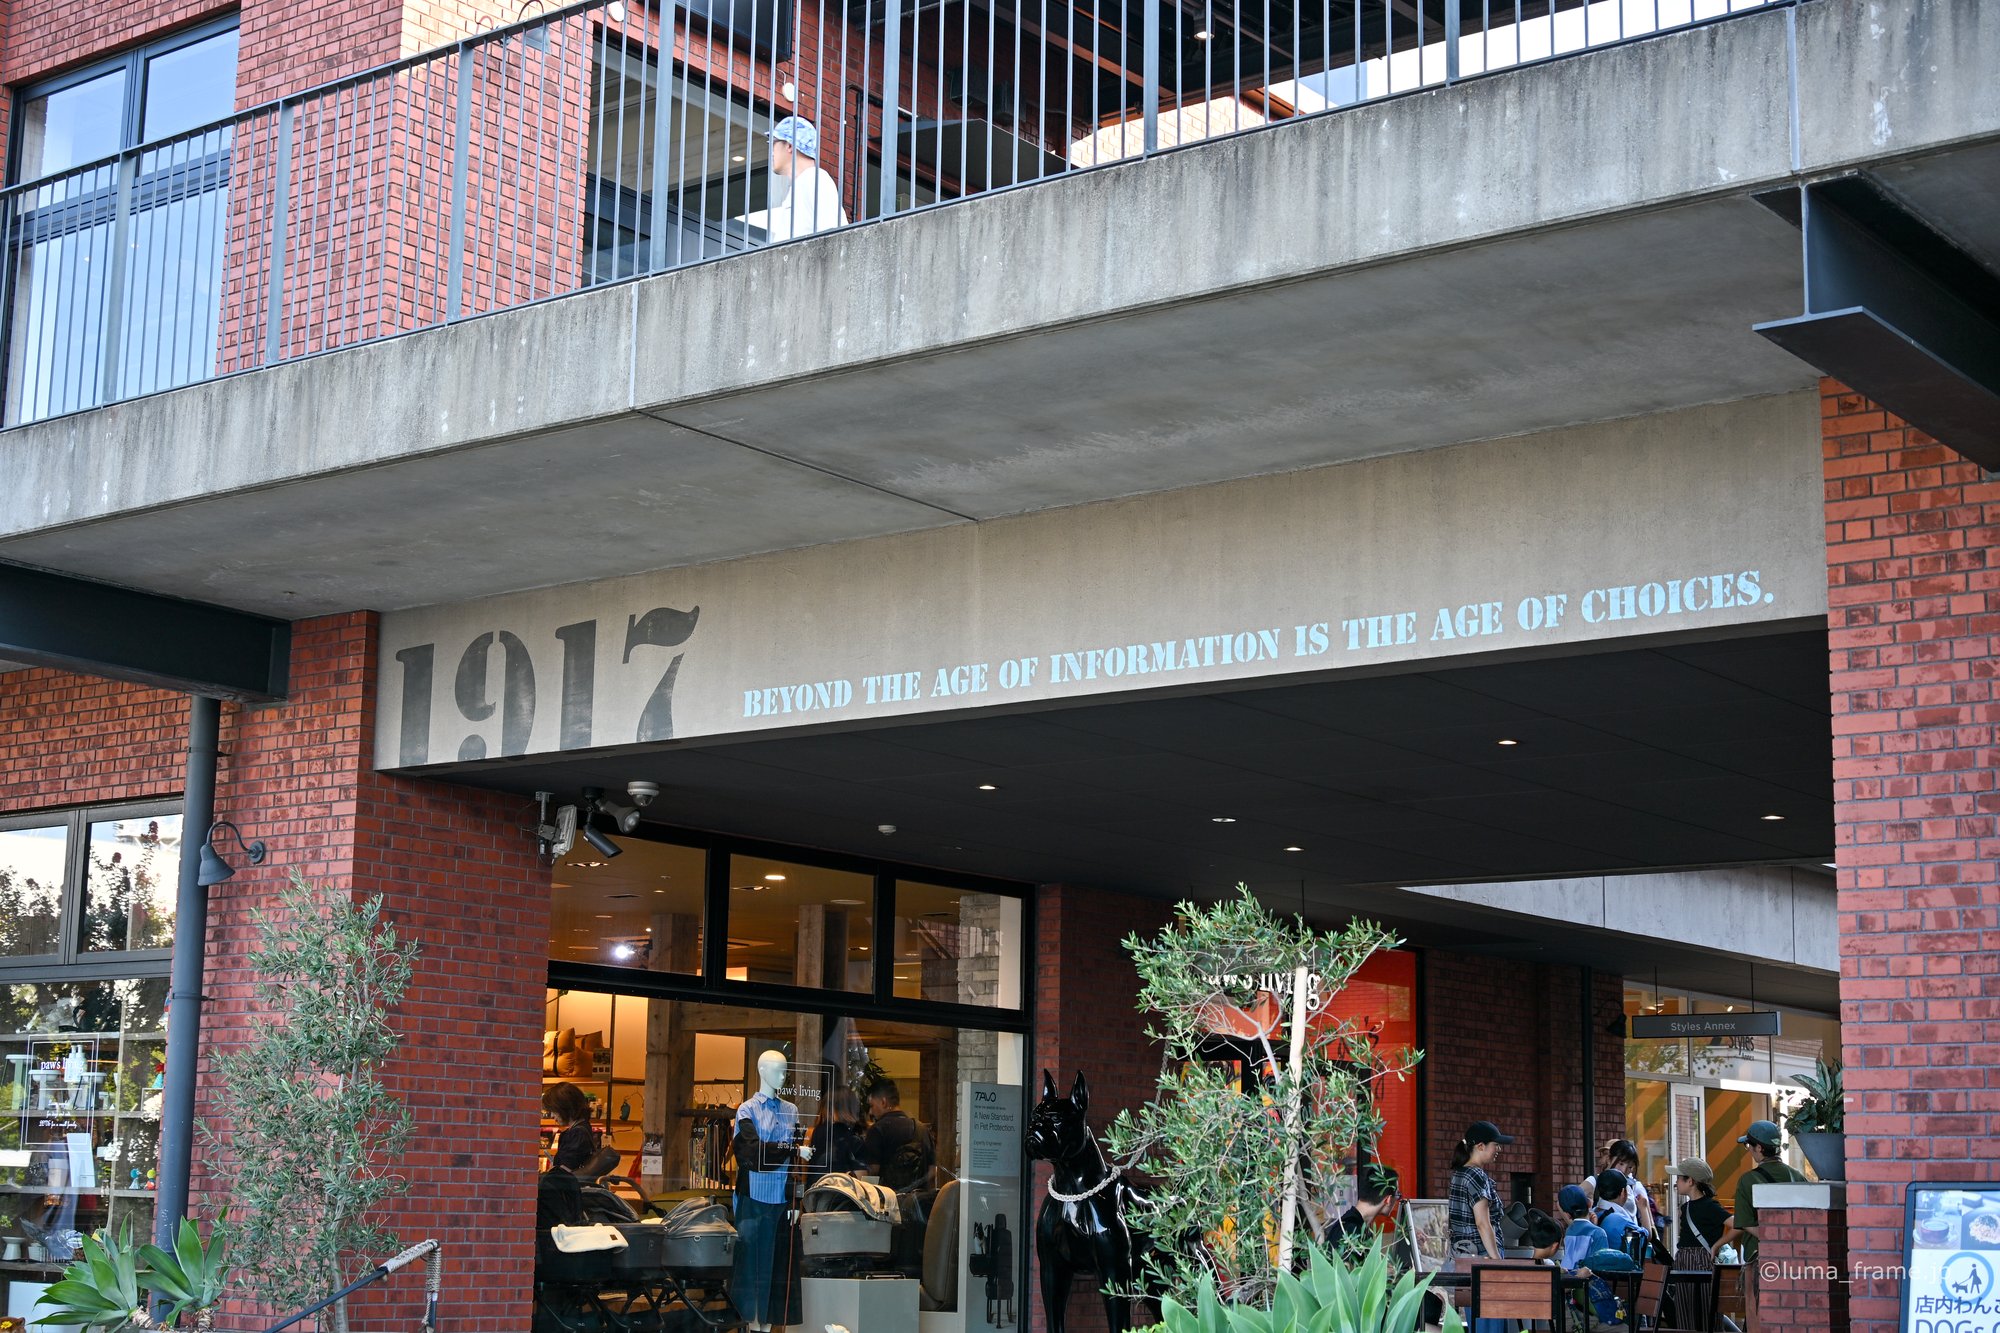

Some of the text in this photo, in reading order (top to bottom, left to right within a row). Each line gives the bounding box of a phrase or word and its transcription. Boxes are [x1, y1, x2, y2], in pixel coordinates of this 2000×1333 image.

[743, 569, 1776, 718] BEYOND THE AGE OF INFORMATION IS THE AGE OF CHOICES.
[395, 604, 700, 766] 1917
[1670, 1021, 1736, 1032] Styles Annex
[40, 1057, 61, 1072] paw's
[776, 1084, 822, 1101] paw's living
